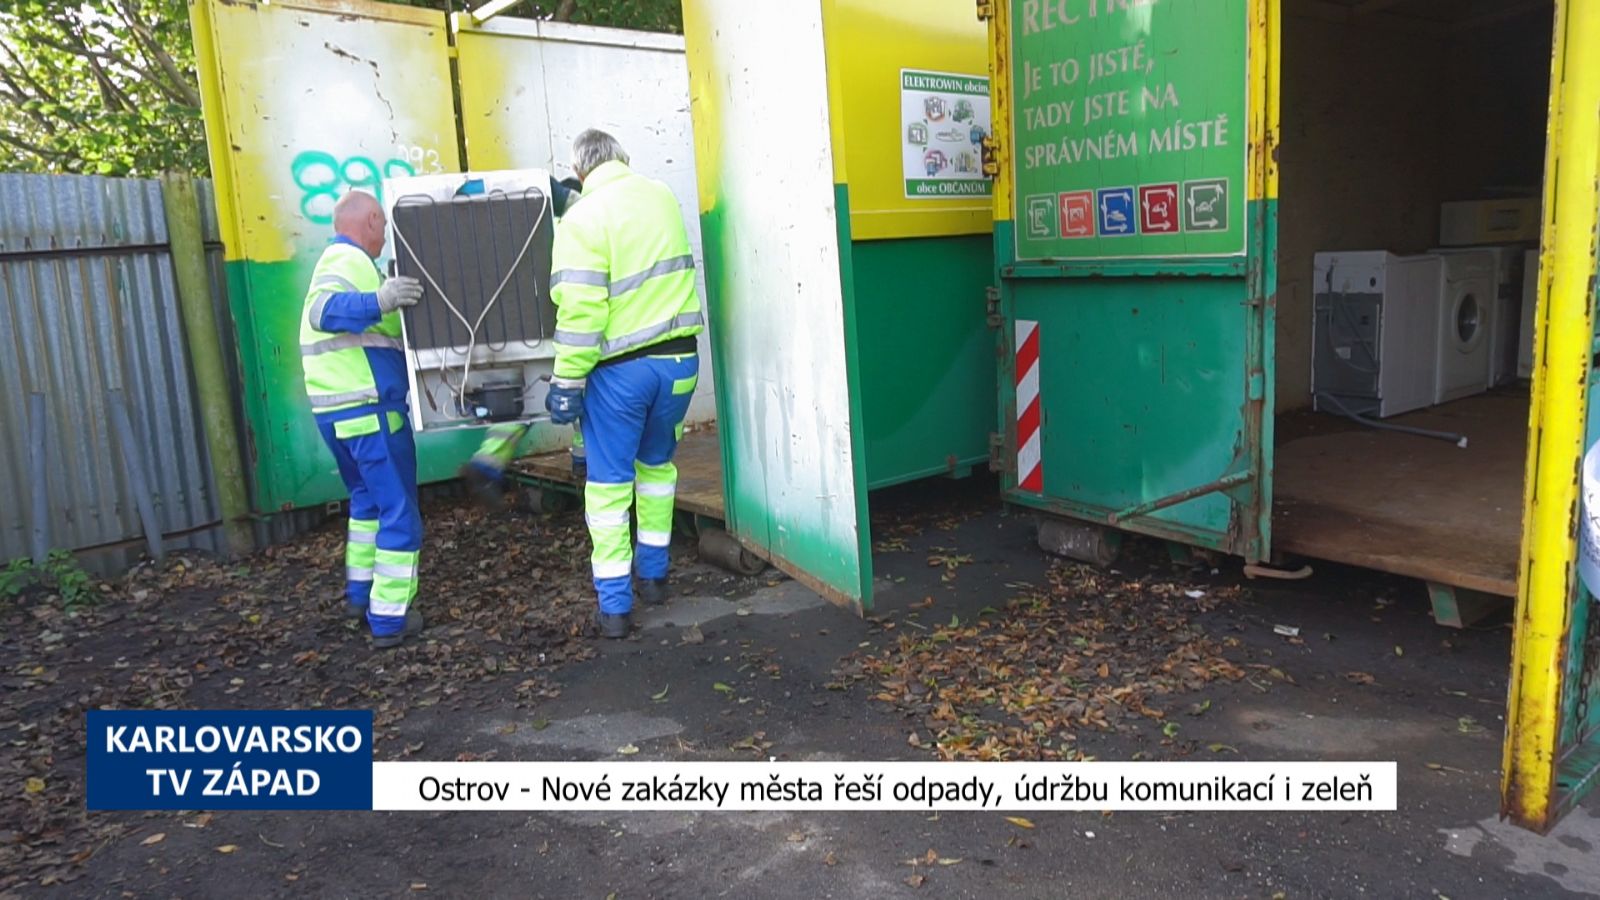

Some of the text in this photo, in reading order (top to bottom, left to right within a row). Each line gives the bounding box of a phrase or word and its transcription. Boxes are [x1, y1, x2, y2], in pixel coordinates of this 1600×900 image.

[904, 75, 963, 91] ELEKTROWIN
[1050, 58, 1079, 86] TO
[1088, 40, 1155, 84] JISTÉ,
[1024, 83, 1179, 131] TADY JSTE NA
[1025, 113, 1229, 169] SPRÁVNÉM MÍSTĚ
[917, 182, 937, 193] obce
